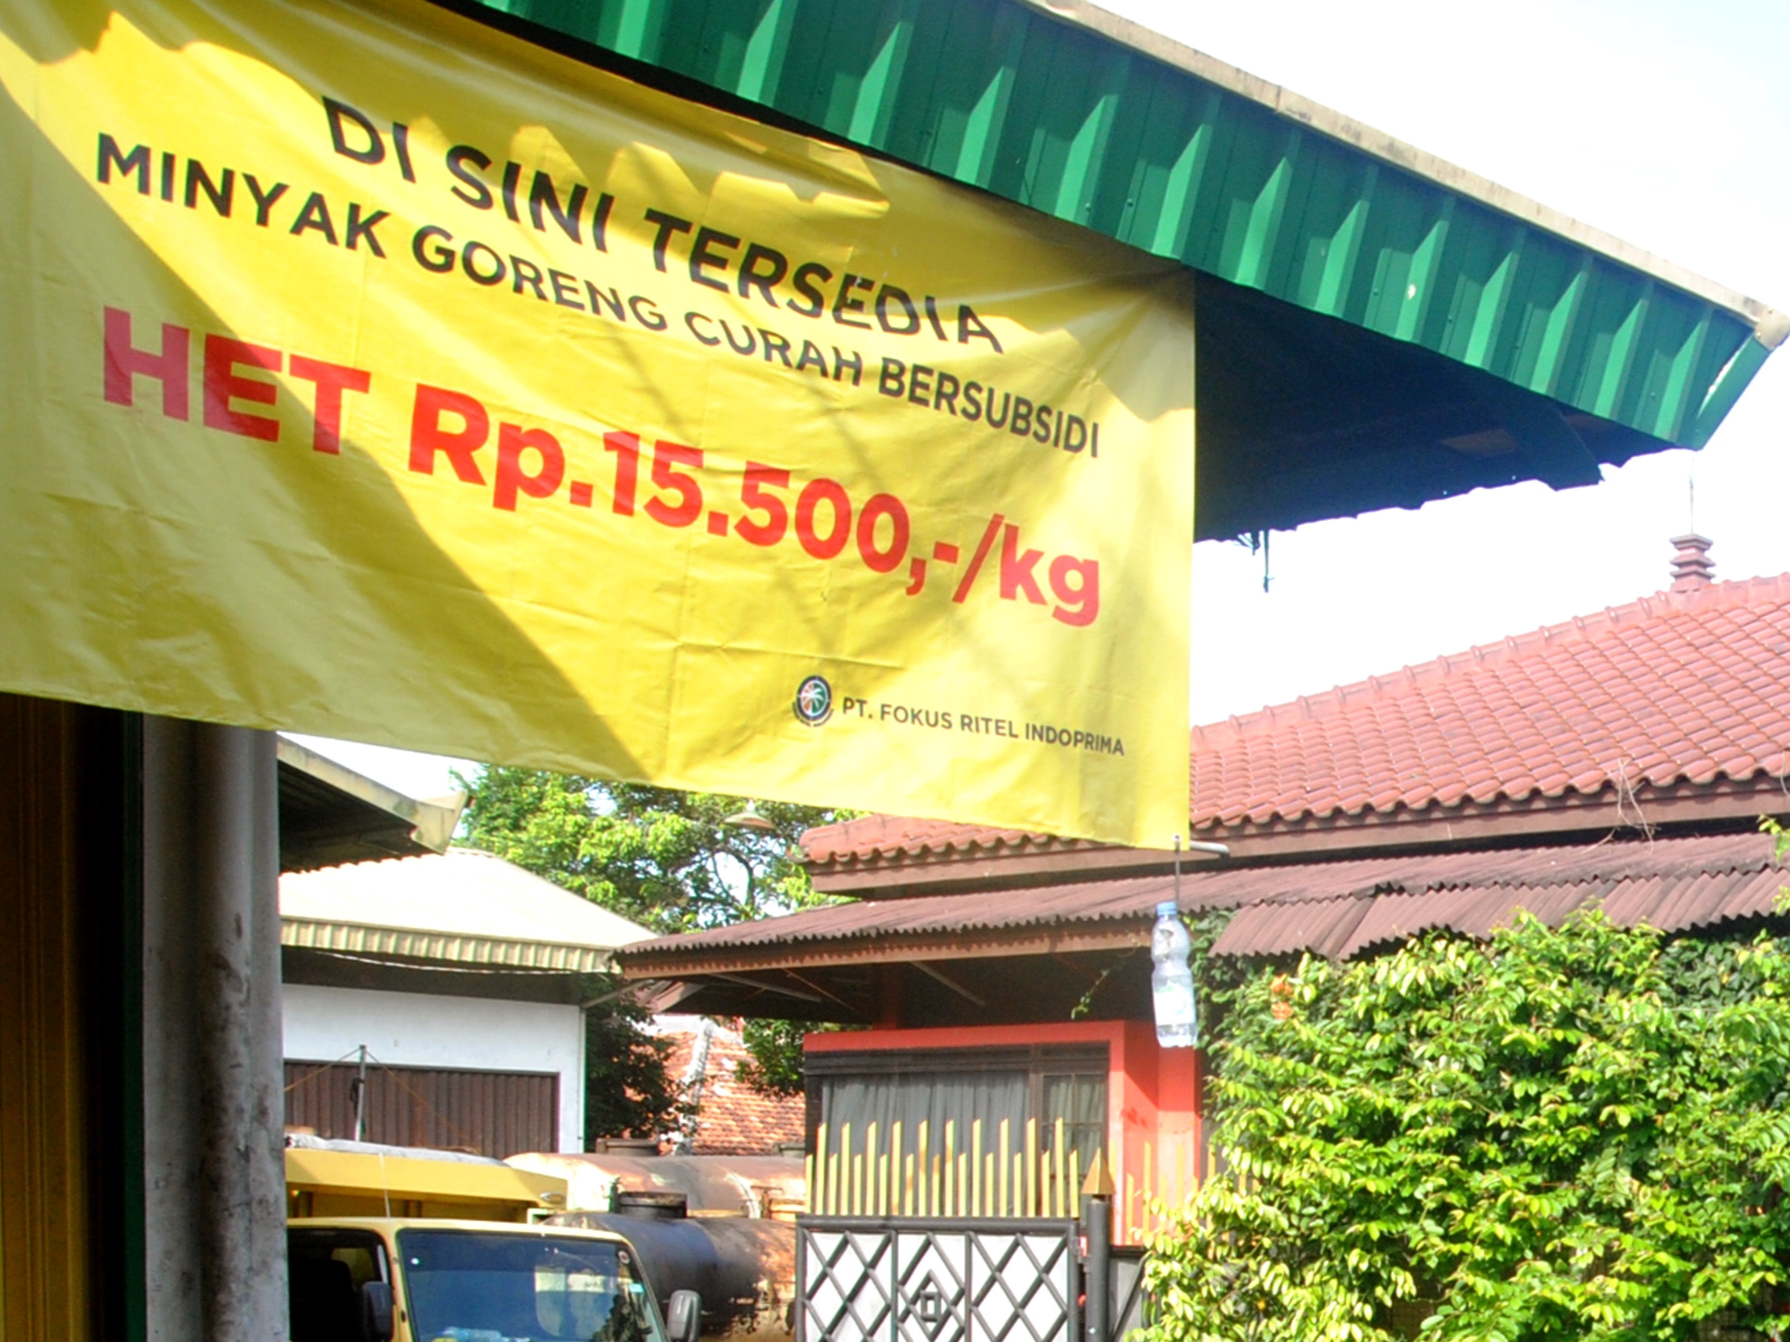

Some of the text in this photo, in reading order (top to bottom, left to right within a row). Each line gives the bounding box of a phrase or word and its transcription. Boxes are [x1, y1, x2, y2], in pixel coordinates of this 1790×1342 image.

[96, 131, 1099, 458] MINYAK GORENG CURAH BERSUBSIDI
[321, 95, 1004, 355] DI SINI TERSEDIA
[103, 305, 1100, 627] HET Rp.15.500,-/kg
[842, 696, 1125, 757] PT. FOKUS RITEL INDOPRIMA
